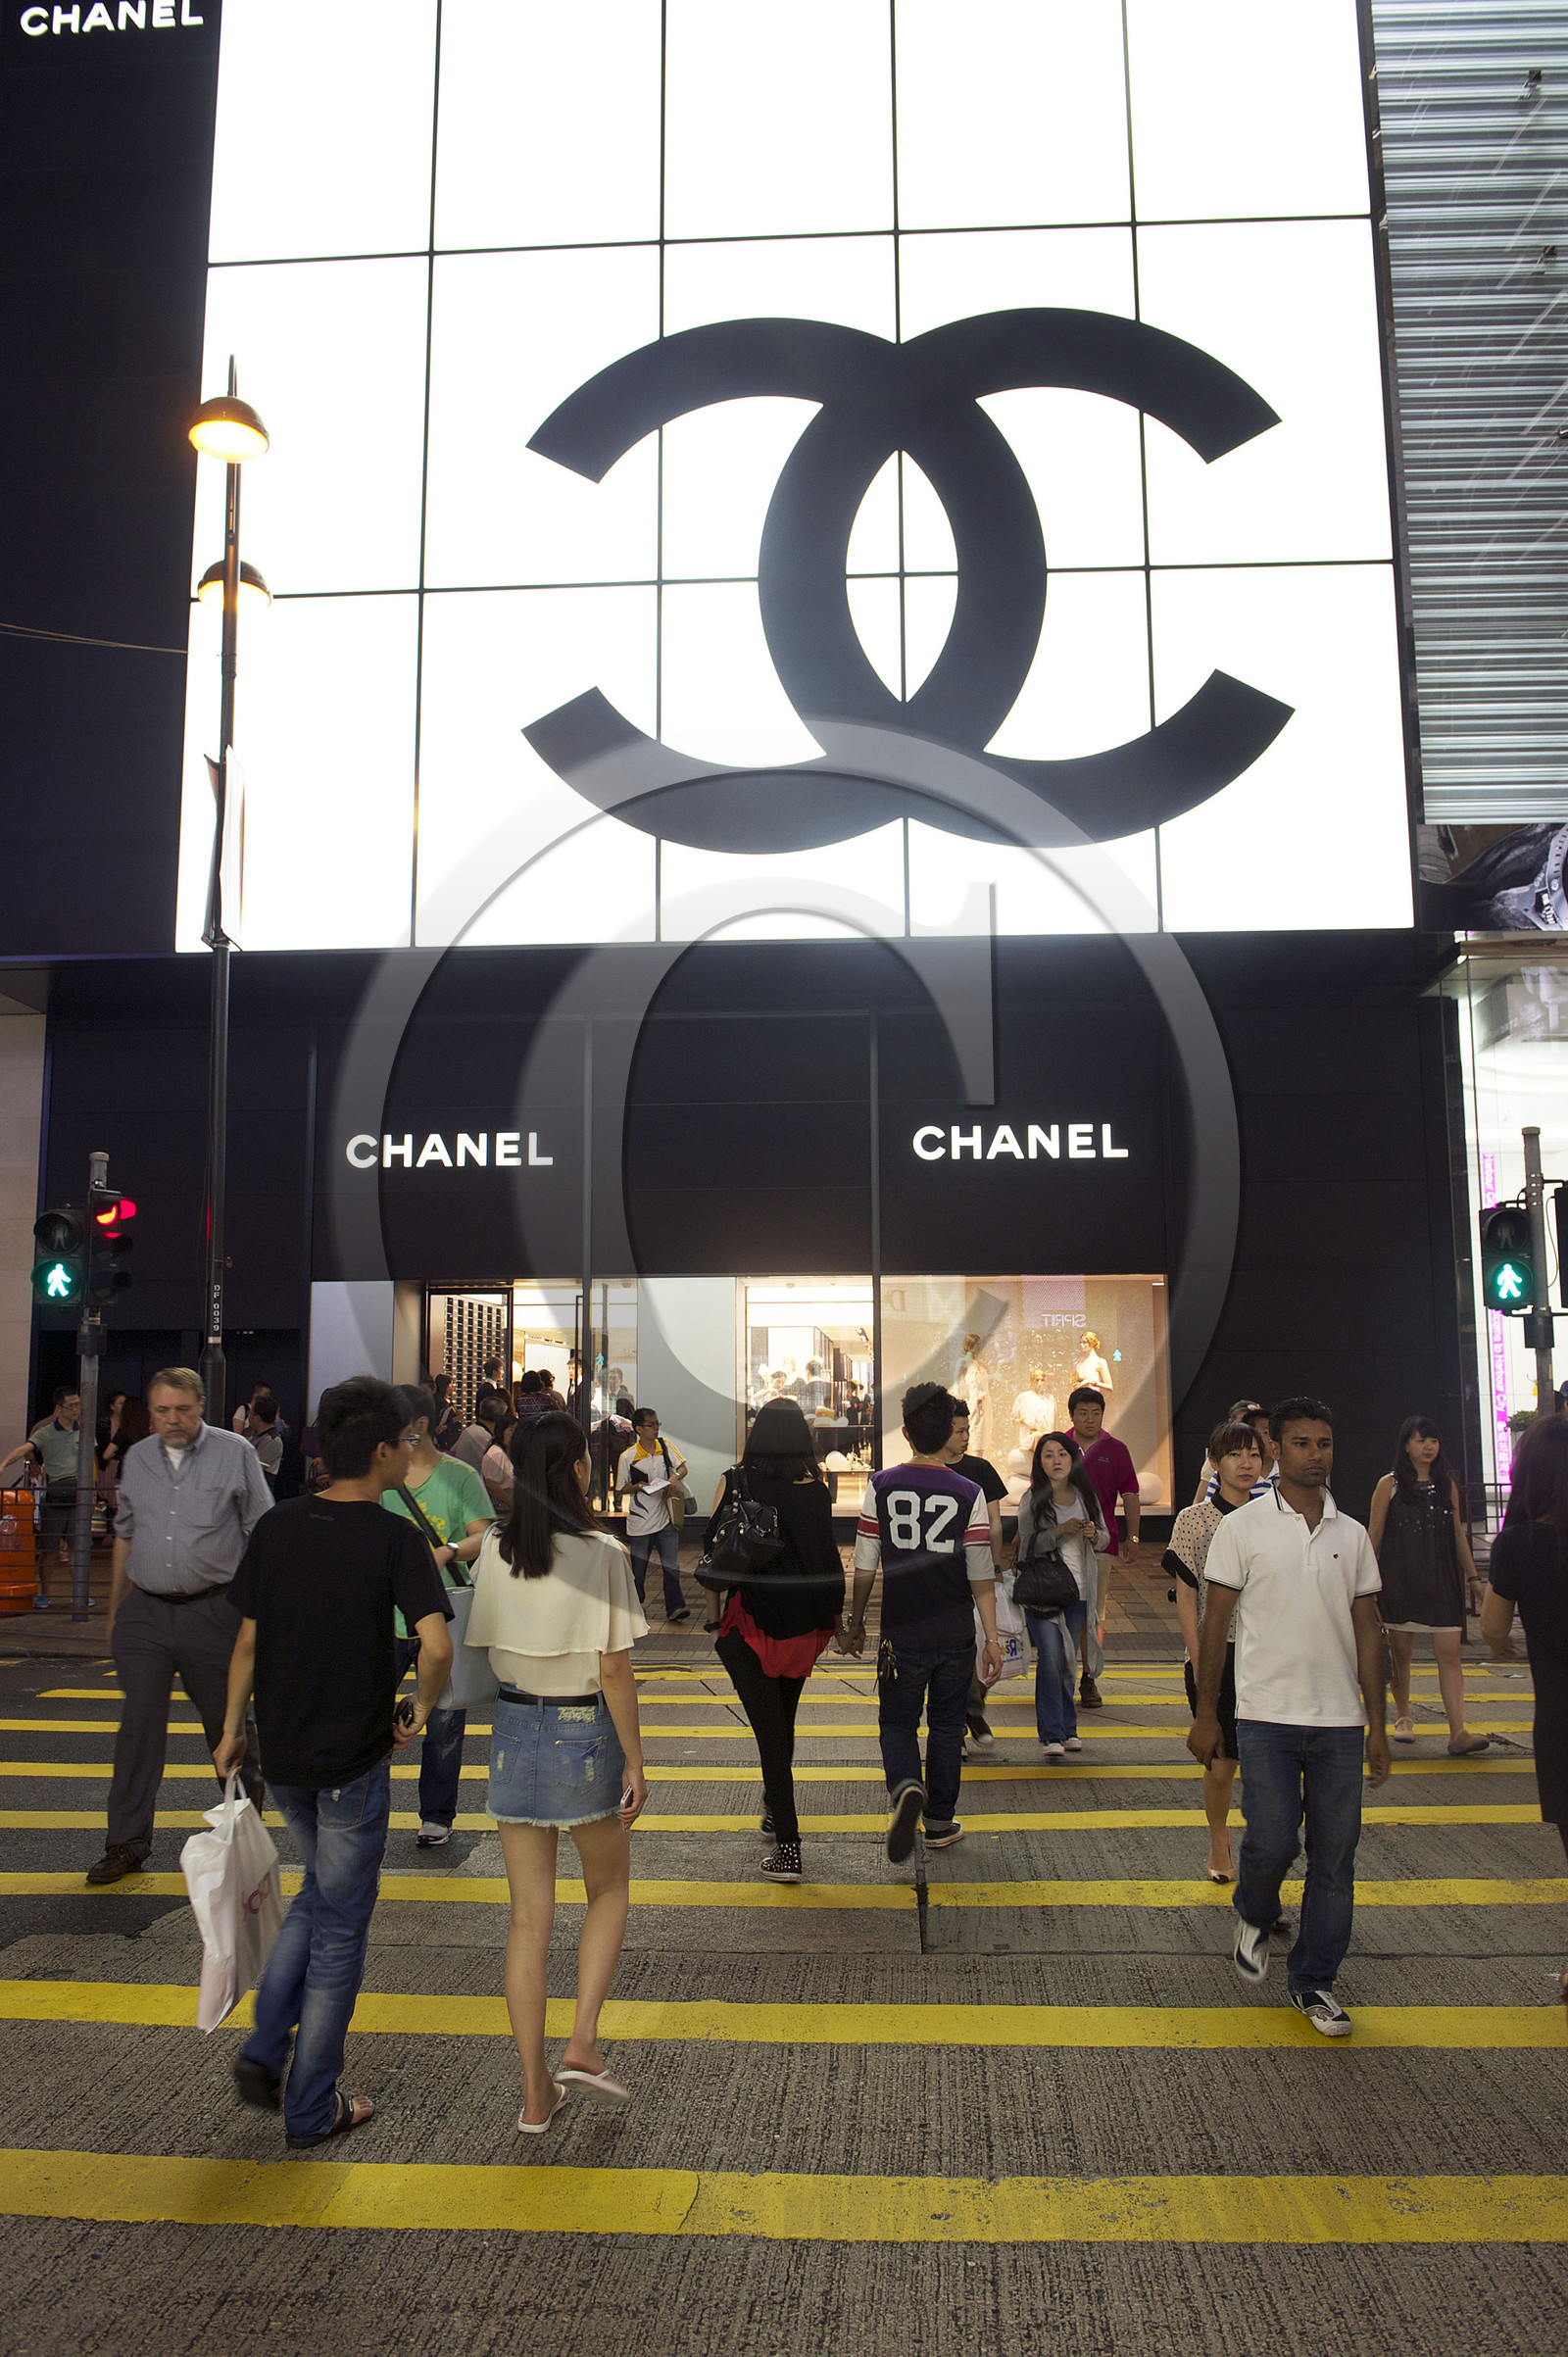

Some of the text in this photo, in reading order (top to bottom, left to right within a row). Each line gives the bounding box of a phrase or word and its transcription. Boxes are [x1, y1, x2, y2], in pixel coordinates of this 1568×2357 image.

[20, 0, 204, 36] CHANEL
[345, 1132, 554, 1168] CHANEL
[911, 1123, 1129, 1160] CHANEL
[213, 1284, 220, 1299] DF
[1494, 1354, 1506, 1392] Harbour
[1495, 1394, 1507, 1412] City
[887, 1491, 958, 1553] 82
